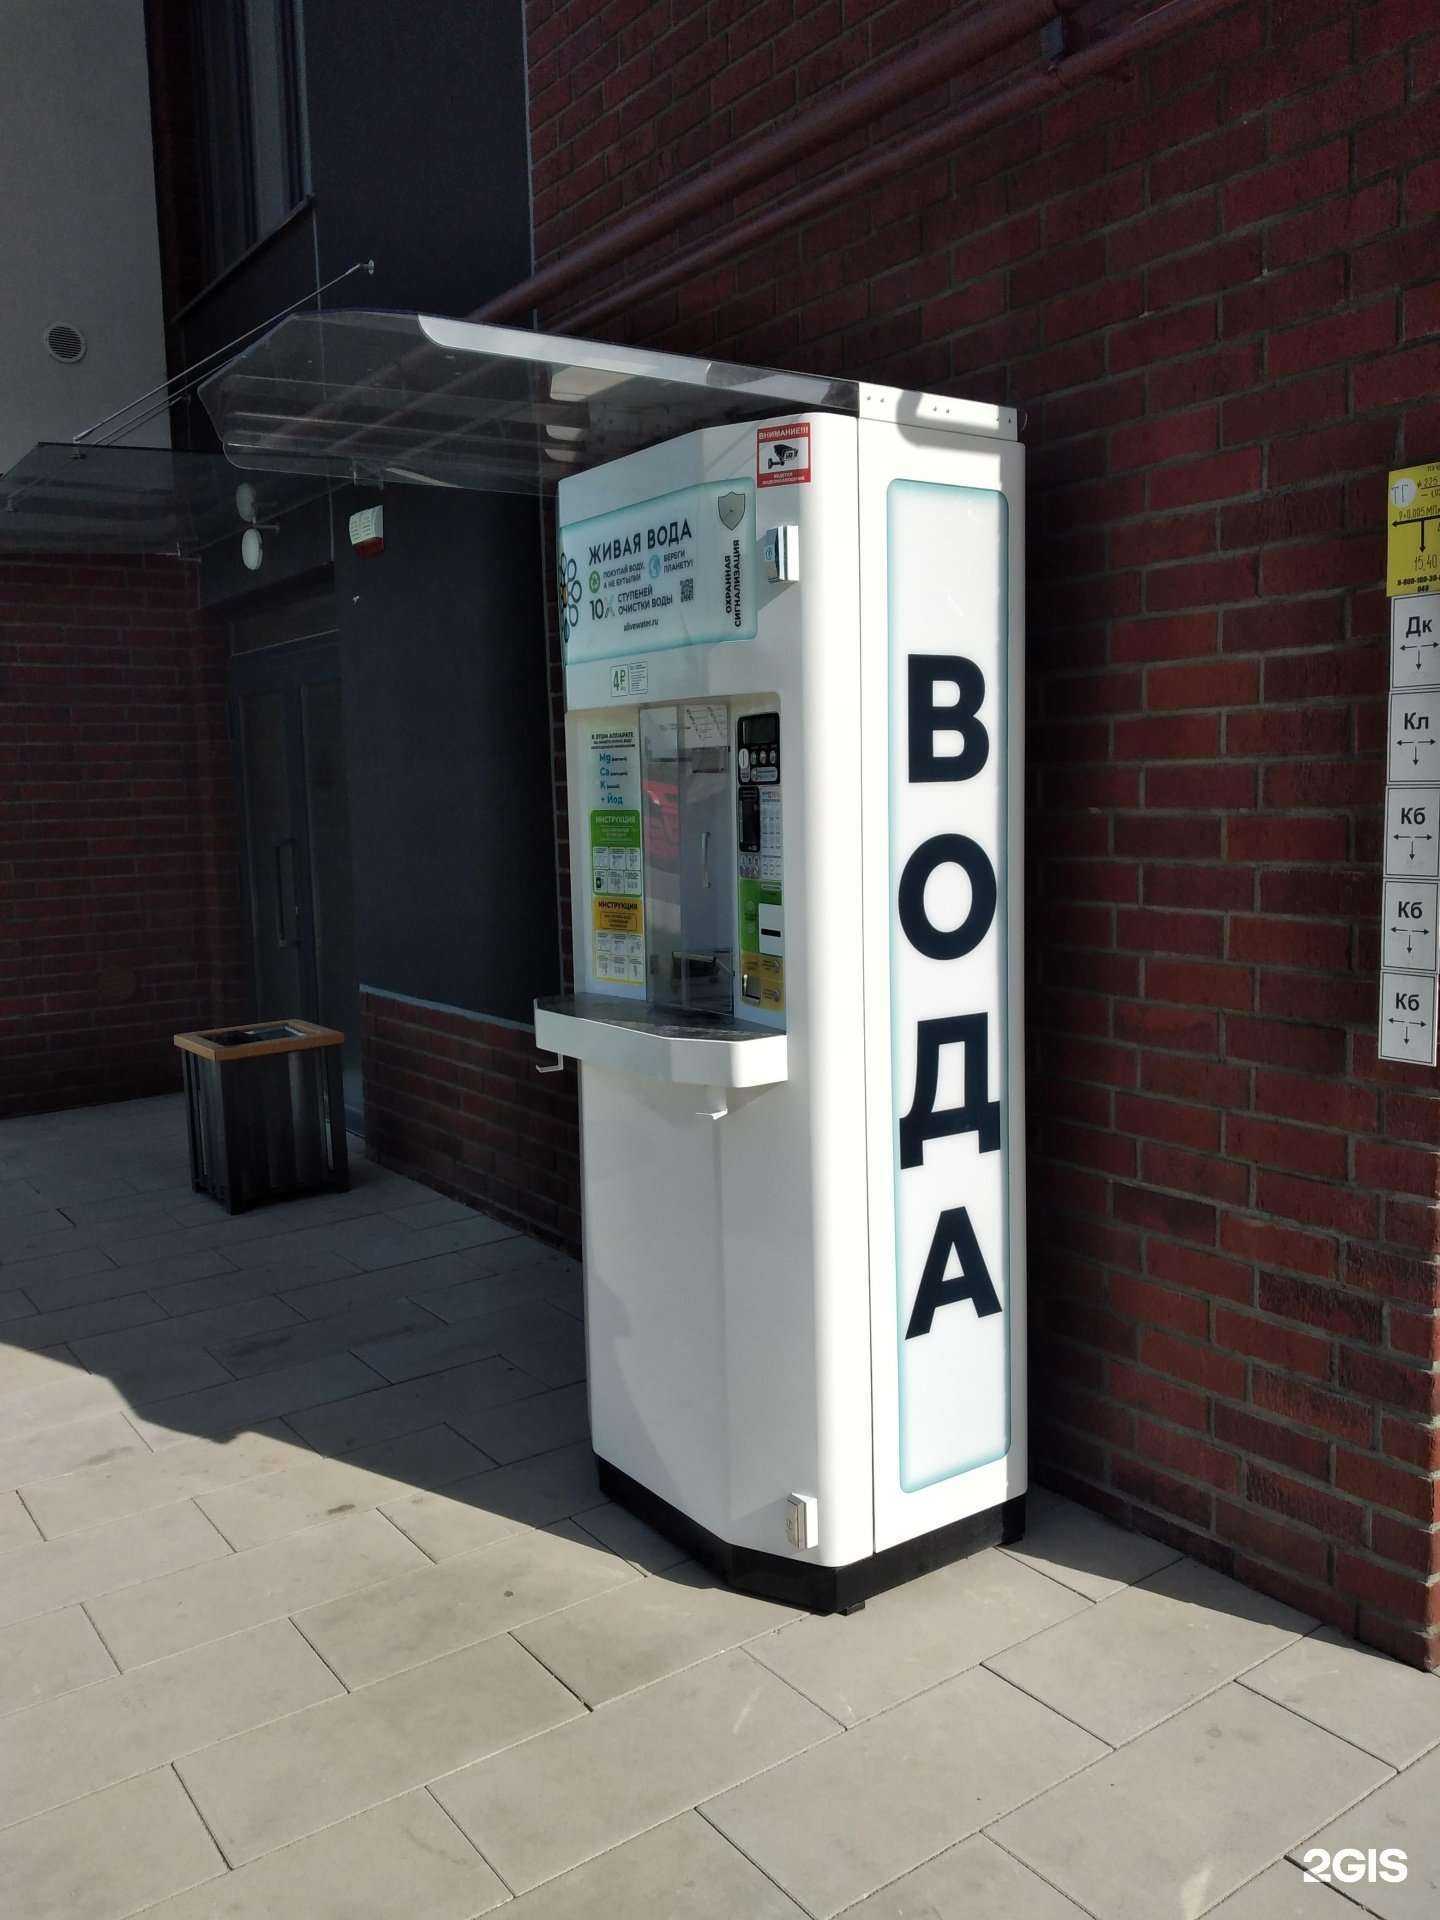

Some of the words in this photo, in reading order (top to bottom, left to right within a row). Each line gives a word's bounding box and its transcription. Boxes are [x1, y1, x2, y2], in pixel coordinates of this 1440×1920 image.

[759, 426, 809, 439] ВНИМАНИЕ!!!
[588, 532, 641, 567] ЖИВАЯ
[647, 518, 692, 549] ВОДА
[664, 550, 686, 562] БЕРЕГИ
[603, 564, 629, 578] ПОКУПАЙ
[664, 559, 694, 573] ПЛАНЕТУ!
[724, 555, 732, 614] ОХРАННАЯ
[733, 539, 742, 627] СИГНАЛИЗАЦИЯ
[618, 584, 653, 603] СТУПЕНЕЙ
[618, 601, 651, 616] ОЧИСТКИ
[651, 594, 673, 608] ВОДЫ
[1405, 616, 1433, 638] Дк
[1403, 712, 1429, 730] Кл
[600, 753, 611, 764] Mg
[607, 793, 623, 805] Йод
[595, 816, 636, 825] ИНСТРУКЦИЯ
[1400, 807, 1426, 825] Кб
[598, 900, 638, 910] ИНСТРУКЦИЯ
[1398, 901, 1423, 919] Кб
[898, 653, 1003, 1340] ВОДА
[1395, 992, 1420, 1012] Кб
